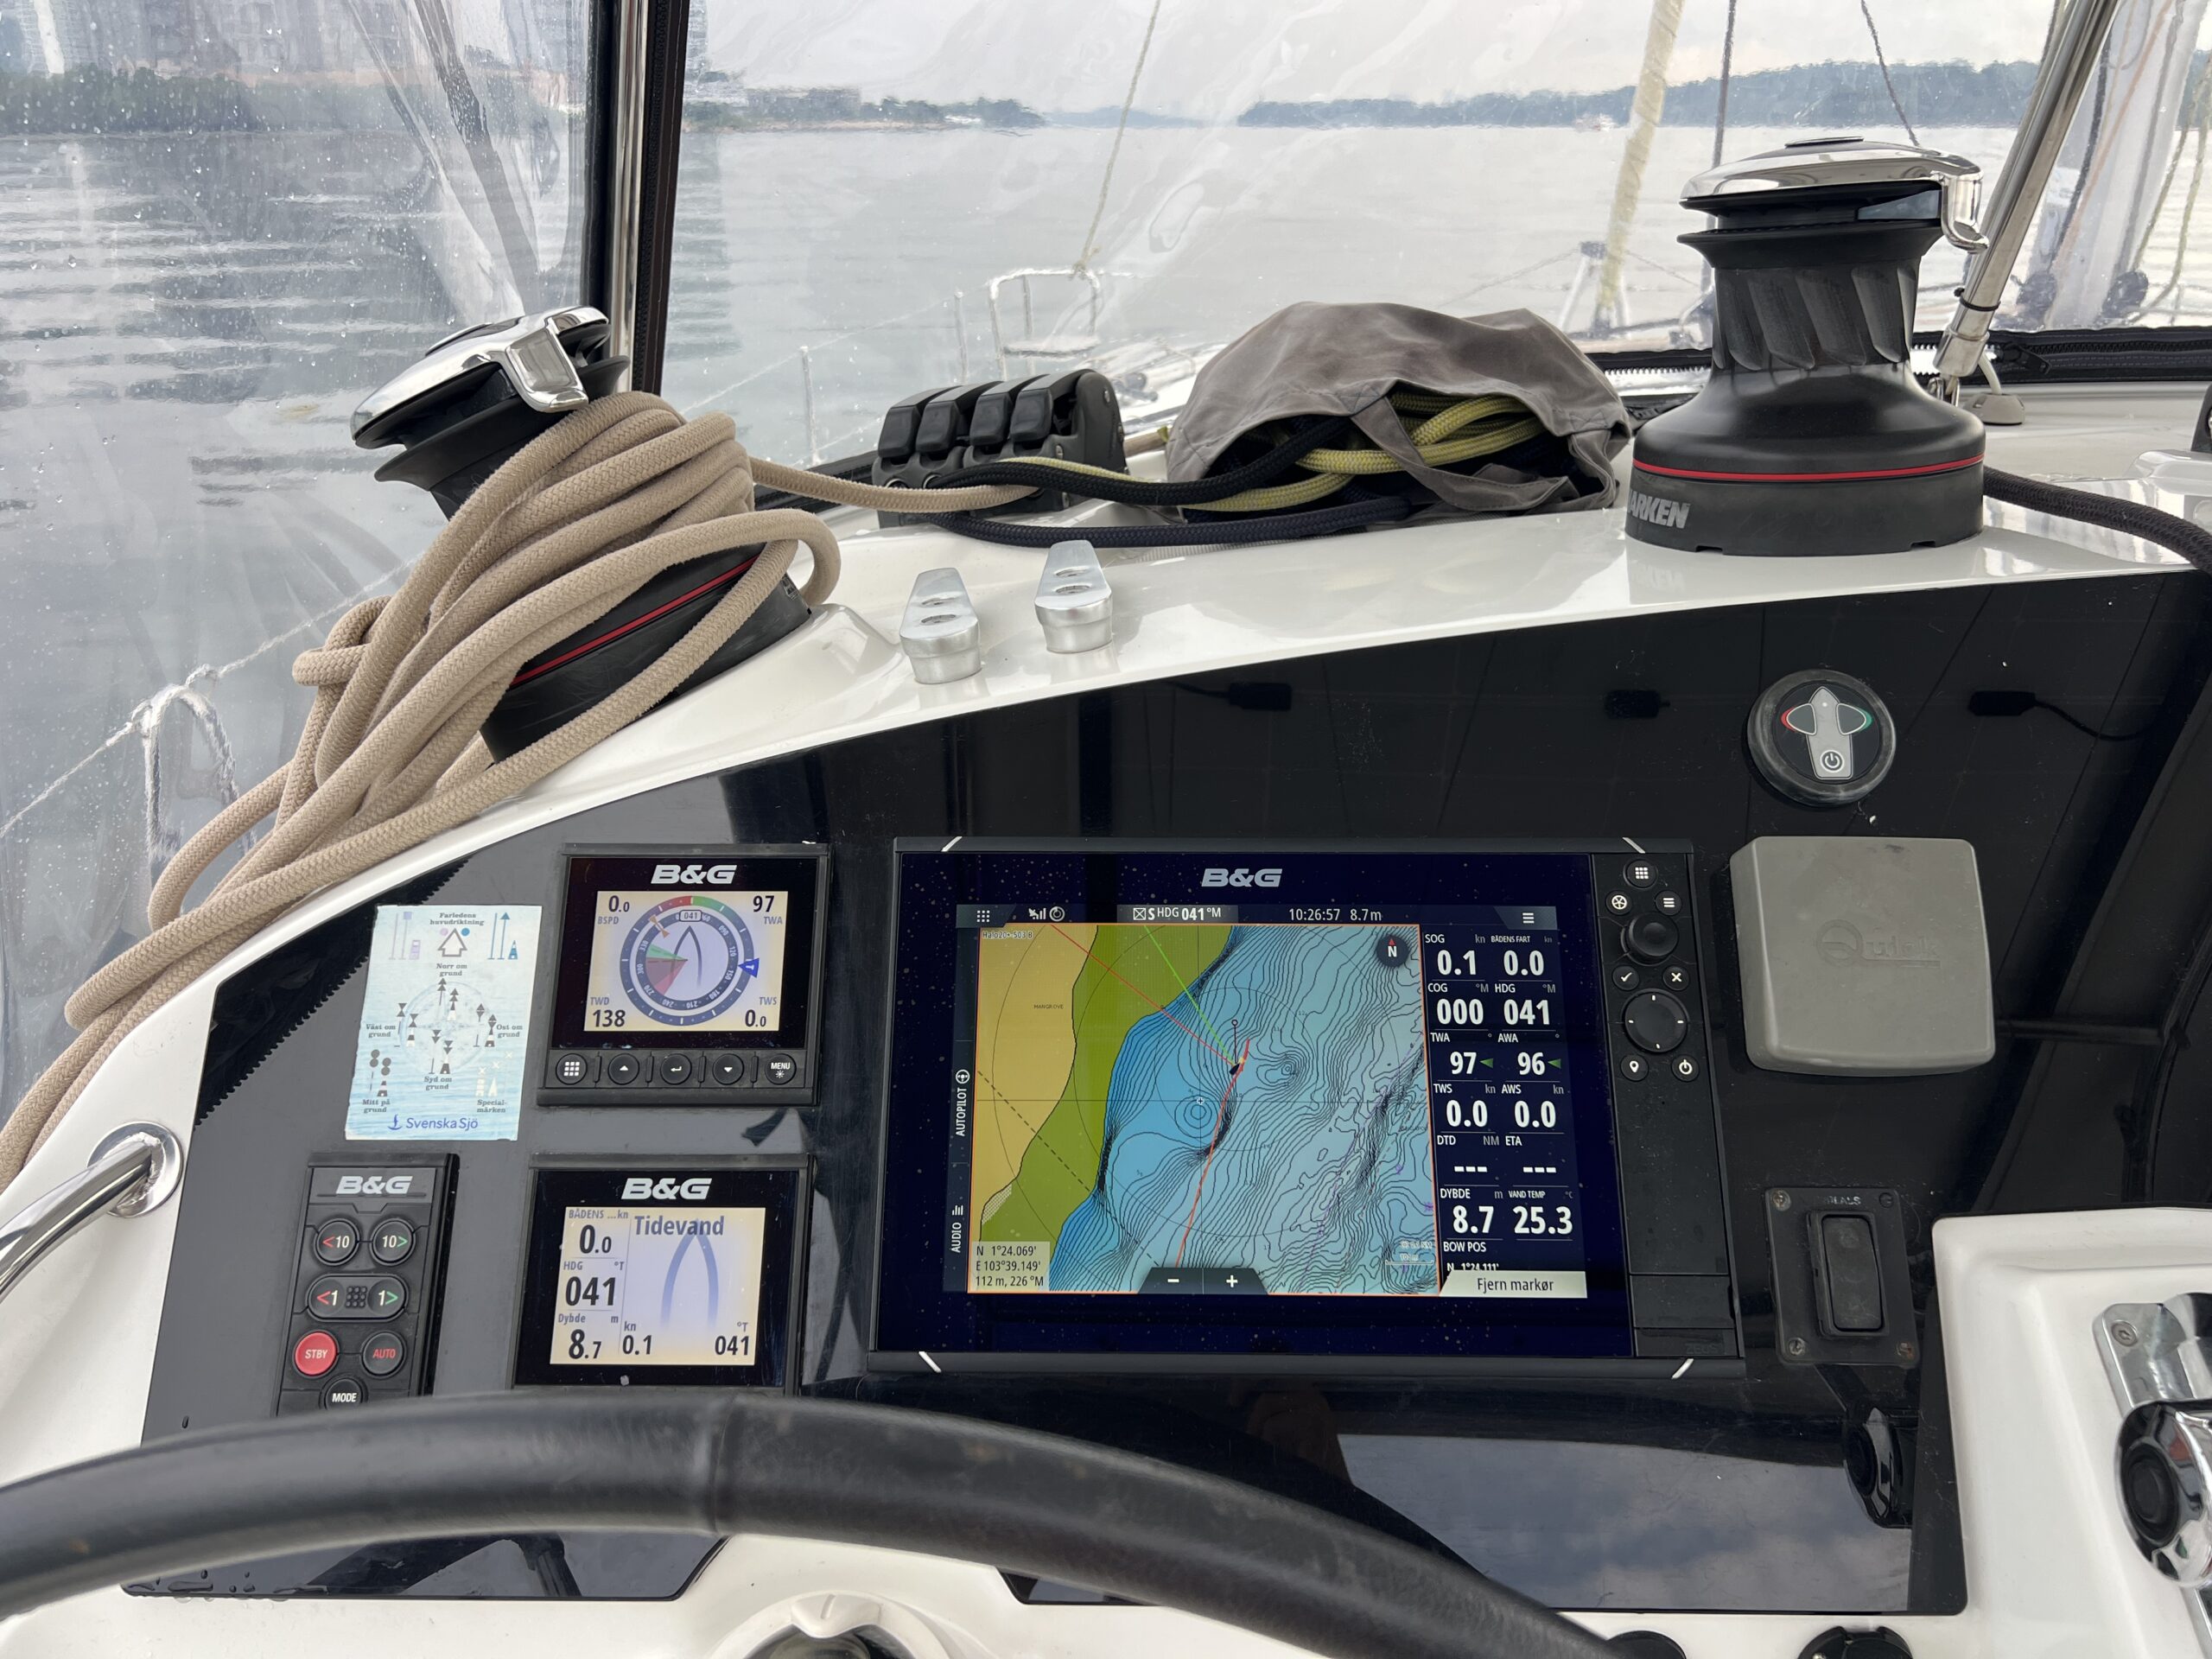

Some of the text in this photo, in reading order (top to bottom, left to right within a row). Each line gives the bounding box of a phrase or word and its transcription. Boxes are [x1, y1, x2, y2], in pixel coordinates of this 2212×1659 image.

[651, 865, 737, 884] B&G
[1201, 868, 1282, 887] B&G
[608, 895, 630, 912] 0.0
[753, 895, 774, 912] 97
[1157, 907, 1179, 918] HDG
[1288, 908, 1340, 921] 10:26:57
[597, 916, 620, 925] BSPD
[763, 917, 783, 925] TWA
[1425, 934, 1486, 944] SOG kn
[1388, 945, 1397, 957] N
[1437, 950, 1477, 976] 0.1
[1503, 950, 1544, 976] 0.0
[1427, 983, 1448, 993] COG
[1495, 983, 1516, 993] HDG
[589, 997, 609, 1006] TWD
[759, 996, 778, 1006] TWS
[592, 1009, 626, 1027] 138
[745, 1009, 766, 1027] 0.0
[1436, 999, 1484, 1025] 000
[1503, 999, 1550, 1025] 041
[1430, 1033, 1450, 1042] TWA
[1497, 1033, 1518, 1043] AWA
[770, 1061, 791, 1071] MENU
[1450, 1052, 1477, 1075] 97
[1517, 1052, 1546, 1075] 96
[1433, 1084, 1496, 1094] TWS kn
[1501, 1084, 1564, 1095] AWS kn
[956, 1087, 967, 1136] AUTOPILOT
[1446, 1099, 1488, 1128] 0.0
[1514, 1100, 1556, 1128] 0.0
[1437, 1135, 1499, 1146] DTD NM
[1505, 1136, 1522, 1146] ETA
[336, 1176, 413, 1194] B&G
[620, 1178, 712, 1199] B&G
[1440, 1188, 1503, 1199] DYBDE m
[1508, 1190, 1527, 1198] VAND
[617, 1210, 628, 1219] kn
[1452, 1205, 1494, 1234] 8.7
[1513, 1205, 1573, 1235] 25.3
[634, 1216, 725, 1236] Tidevand
[579, 1224, 612, 1254] 0.0
[951, 1222, 962, 1253] AUDIO
[976, 1246, 983, 1256] N
[1443, 1242, 1486, 1252] BOW POS
[563, 1261, 583, 1270] HDG
[976, 1261, 982, 1271] E
[1446, 1262, 1454, 1271] N
[976, 1276, 994, 1287] 112
[1010, 1276, 1027, 1287] 226
[1477, 1278, 1554, 1294] Fjern markør
[565, 1276, 616, 1306] 041
[558, 1313, 586, 1325] Dybde
[624, 1321, 636, 1332] kn
[568, 1329, 601, 1359] 8.7
[622, 1335, 652, 1355] 0.1
[715, 1335, 749, 1356] 041
[305, 1349, 328, 1358] STBY
[372, 1349, 396, 1358] AUTO
[332, 1393, 357, 1402] MODE
